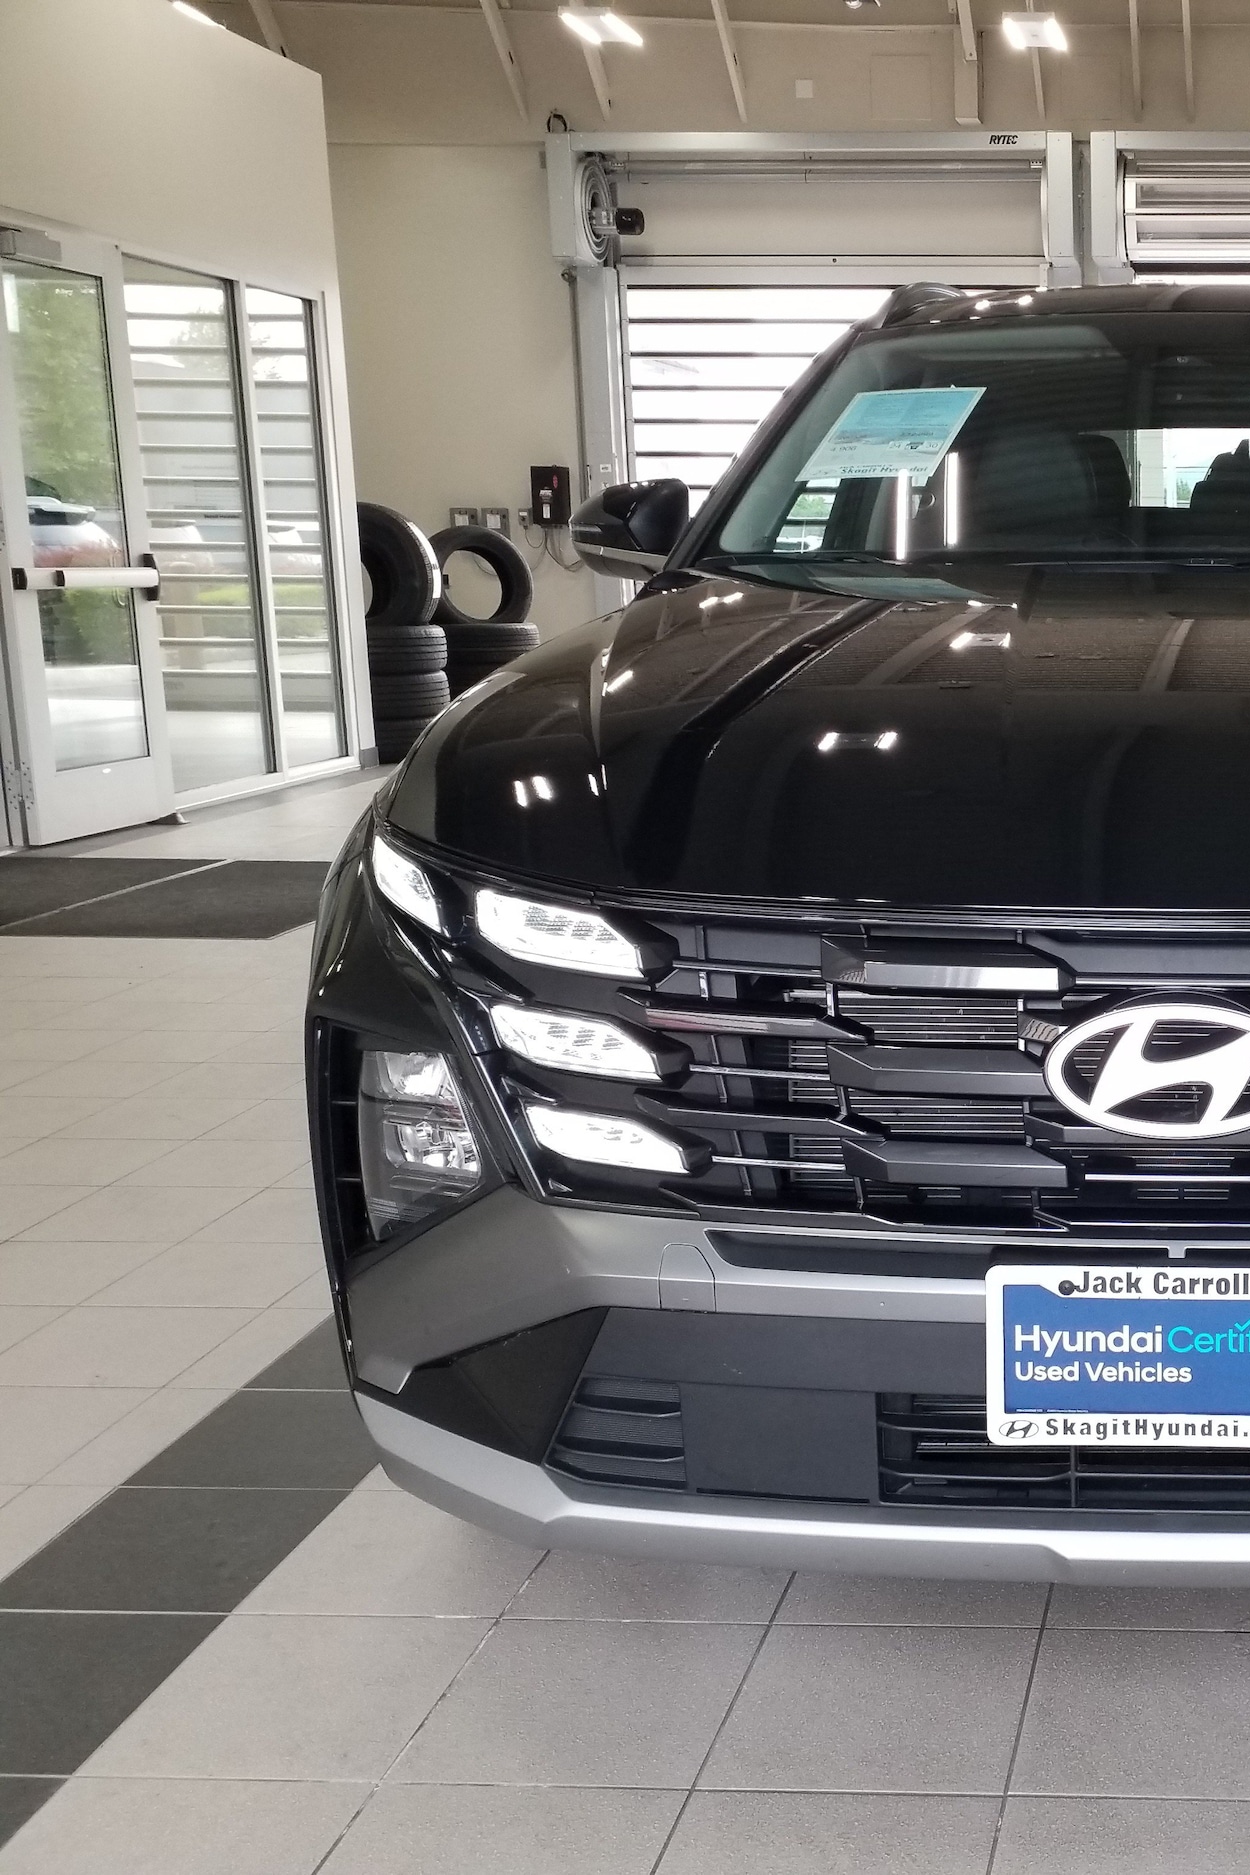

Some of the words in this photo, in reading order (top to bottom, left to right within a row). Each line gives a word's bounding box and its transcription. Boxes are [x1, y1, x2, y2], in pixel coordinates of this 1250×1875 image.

[989, 134, 1018, 145] RYTEC
[1074, 1271, 1142, 1294] Jack
[1014, 1324, 1163, 1358] Hyundai
[1014, 1361, 1080, 1382] Used
[1084, 1361, 1193, 1383] Vehicles
